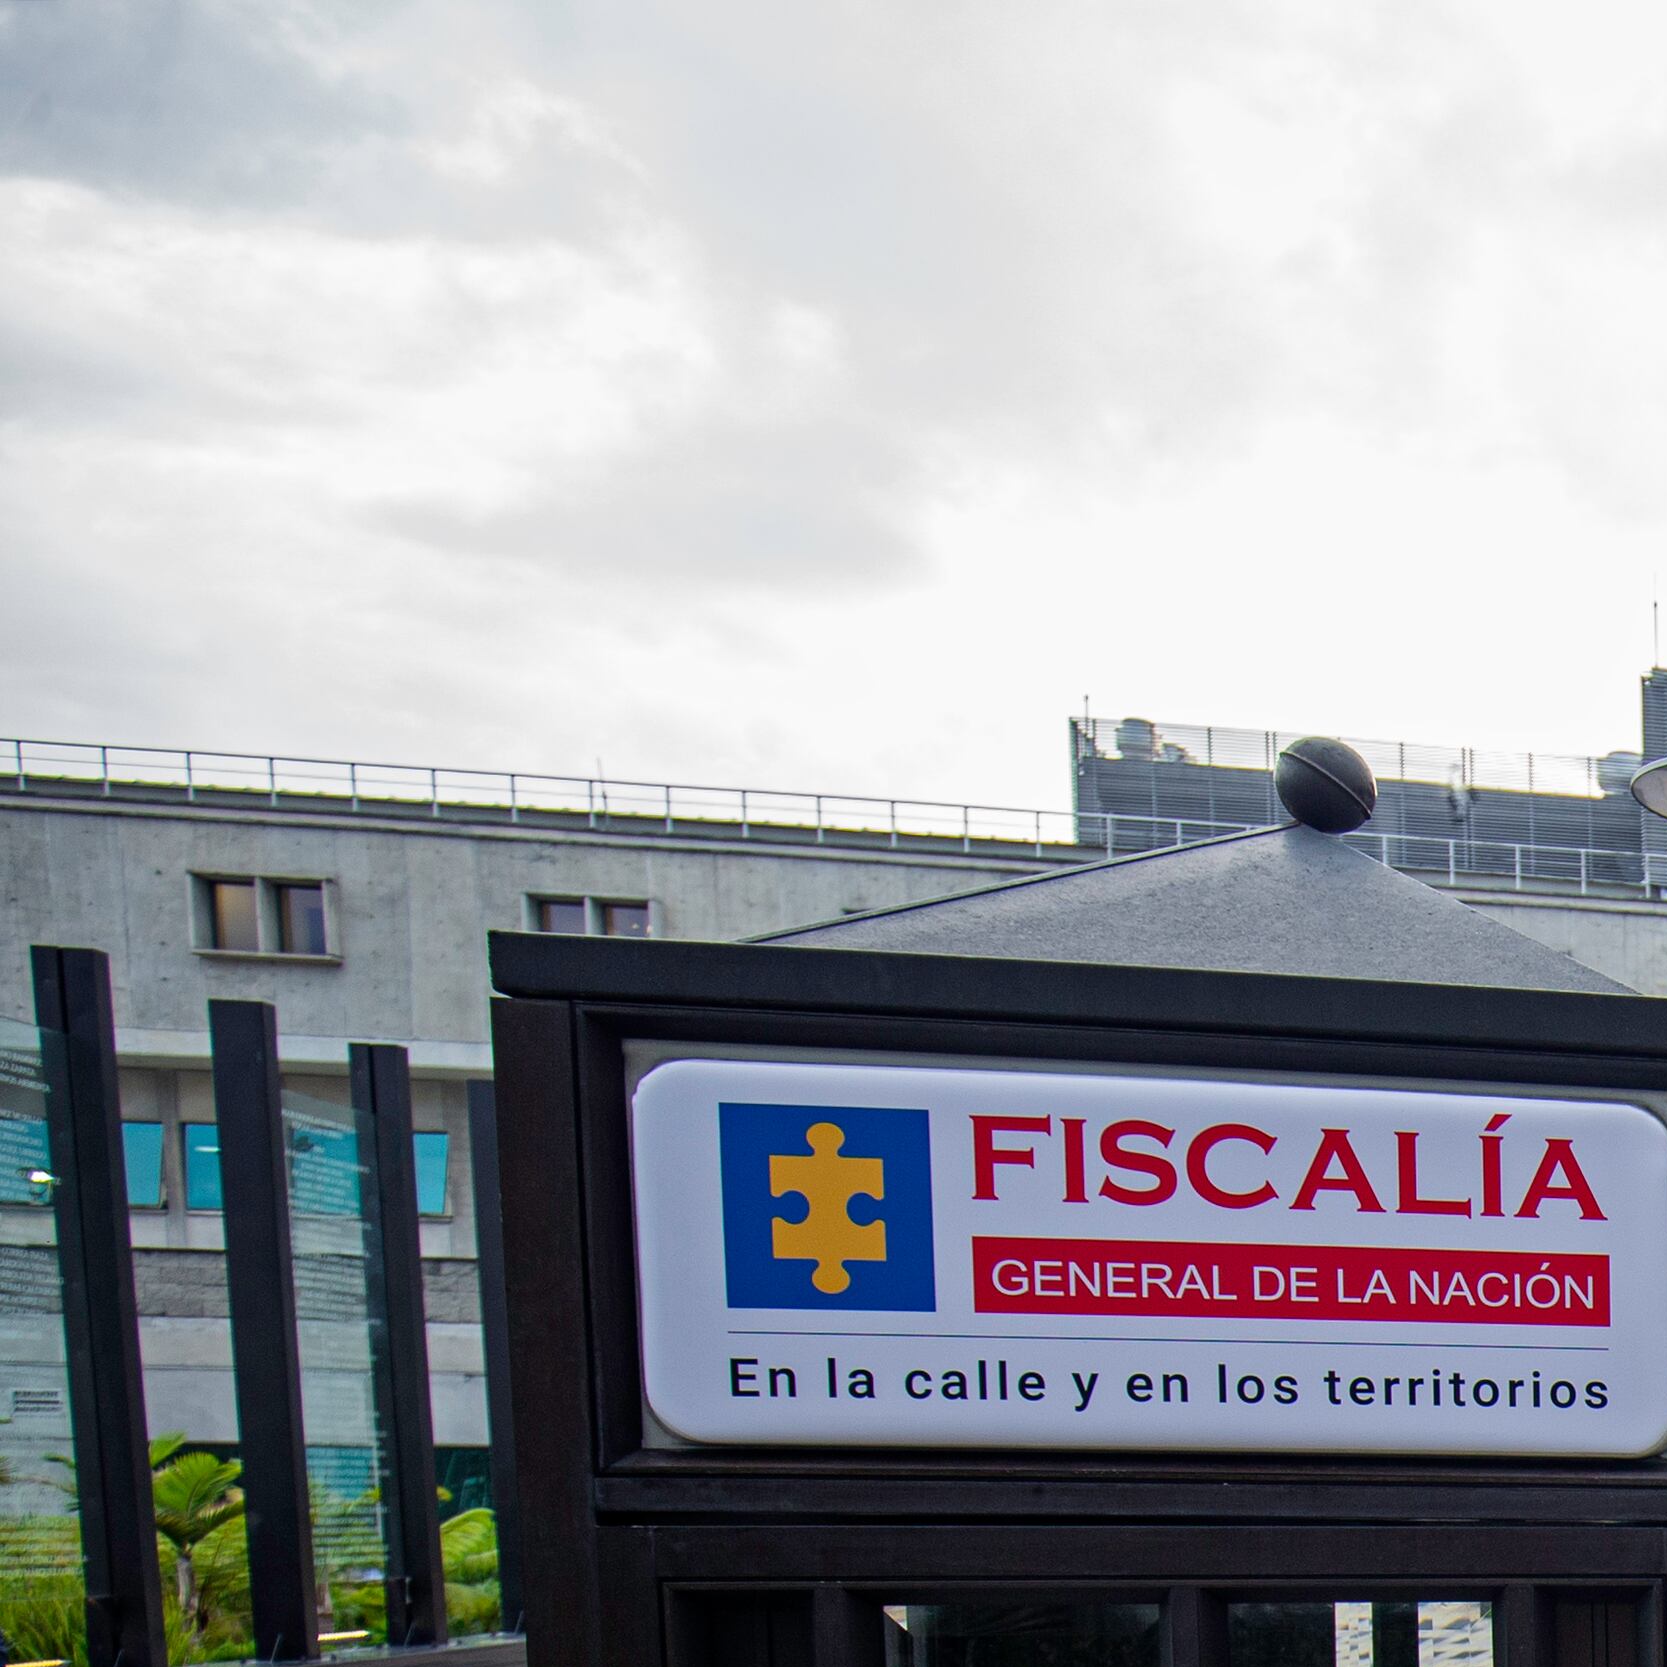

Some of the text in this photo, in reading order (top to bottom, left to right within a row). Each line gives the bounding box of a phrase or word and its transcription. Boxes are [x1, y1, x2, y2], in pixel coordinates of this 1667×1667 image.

[971, 1113, 1607, 1221] FISCALÍA
[992, 1259, 1594, 1309] GENERAL DE LA NACIÓN
[729, 1357, 1608, 1413] En la calle y en los territorios
